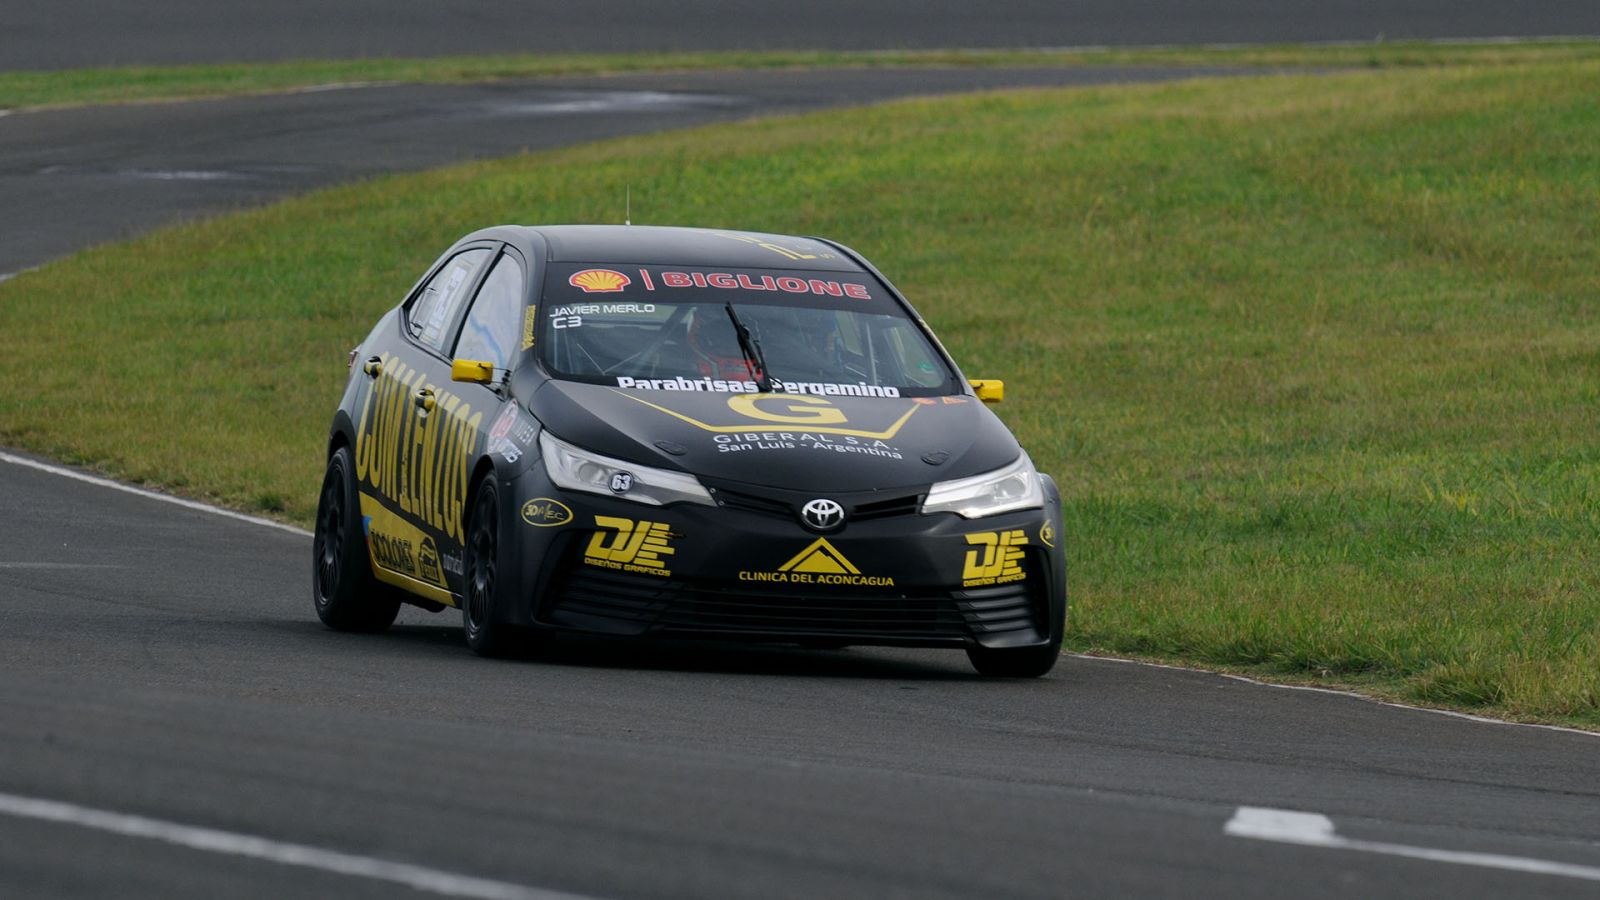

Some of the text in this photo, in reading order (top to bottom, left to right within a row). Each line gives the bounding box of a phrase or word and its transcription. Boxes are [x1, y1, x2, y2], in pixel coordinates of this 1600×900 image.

[661, 271, 872, 299] BIGLIONE
[549, 304, 655, 317] JAVIER MERLO
[552, 315, 582, 329] C3
[616, 376, 759, 394] Parabrisas
[727, 393, 848, 424] G
[713, 432, 833, 444] GIBERAL
[717, 441, 751, 453] San
[757, 440, 795, 450] Luis
[813, 441, 904, 460] Argentina
[612, 474, 631, 490] 63
[739, 571, 895, 587] CLINICA DEL ACONCAGUA
